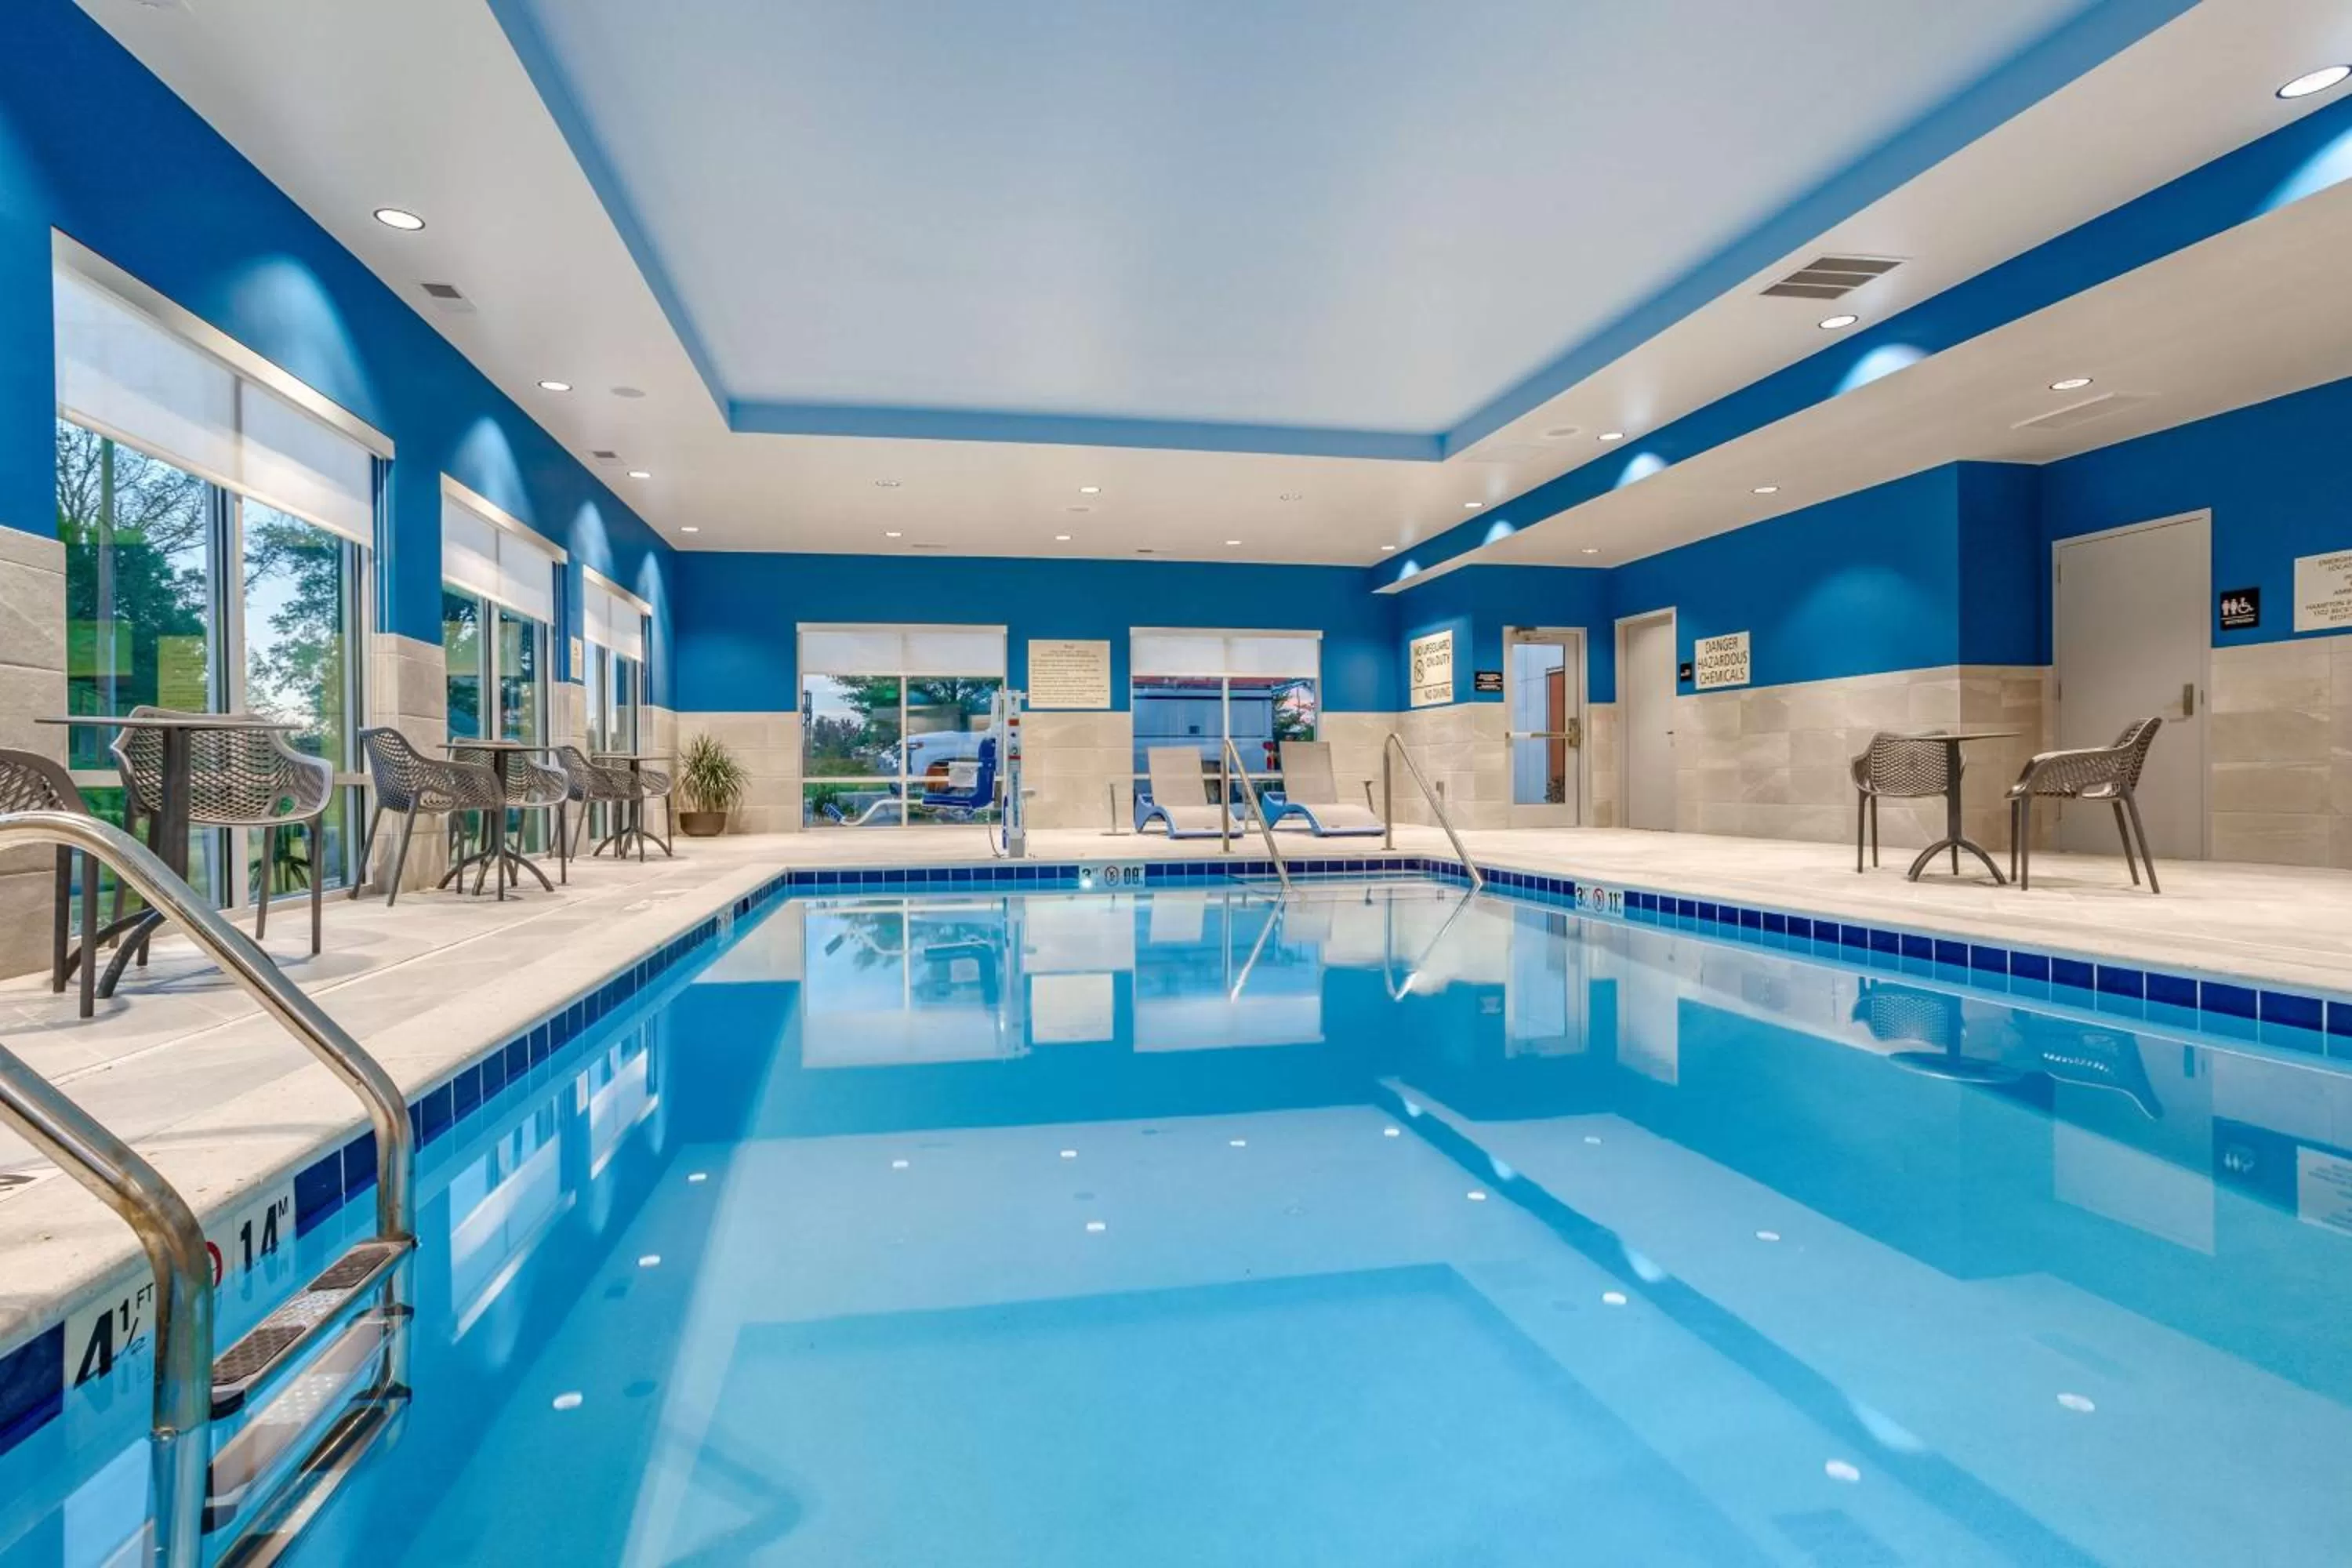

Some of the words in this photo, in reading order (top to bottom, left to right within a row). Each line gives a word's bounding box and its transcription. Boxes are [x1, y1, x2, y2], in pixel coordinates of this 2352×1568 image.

[1705, 637, 1738, 655] DANGER
[1697, 650, 1748, 670] HAZARDOUS
[1699, 667, 1745, 685] CHEMICALS
